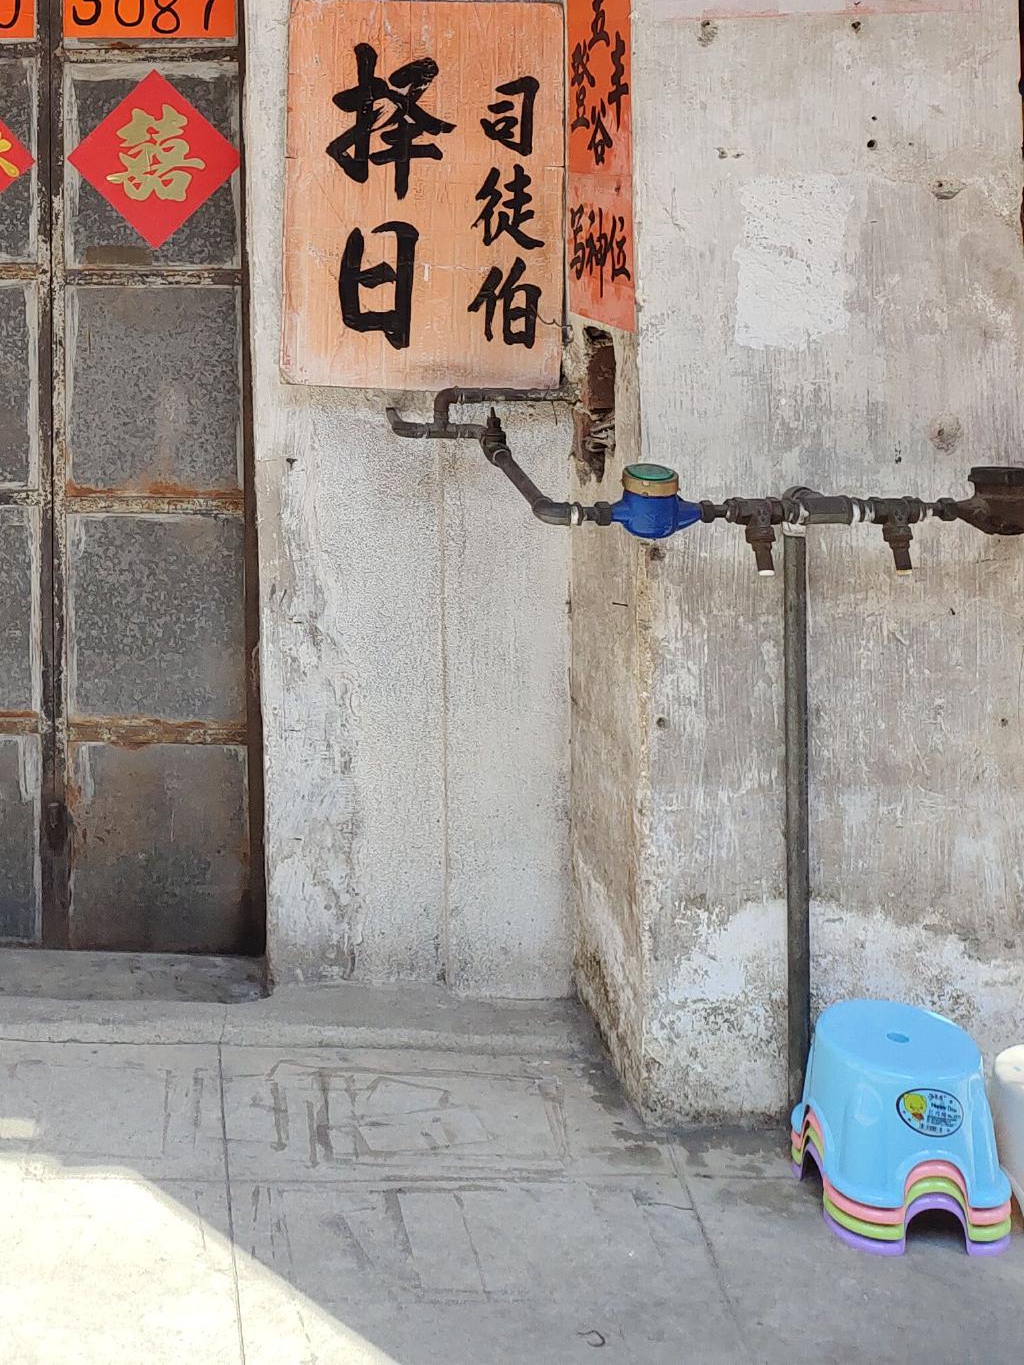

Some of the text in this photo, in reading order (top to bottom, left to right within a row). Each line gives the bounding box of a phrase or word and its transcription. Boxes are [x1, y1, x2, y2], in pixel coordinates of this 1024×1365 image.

[326, 43, 457, 351] 择日
[467, 76, 546, 350] 司徒伯
